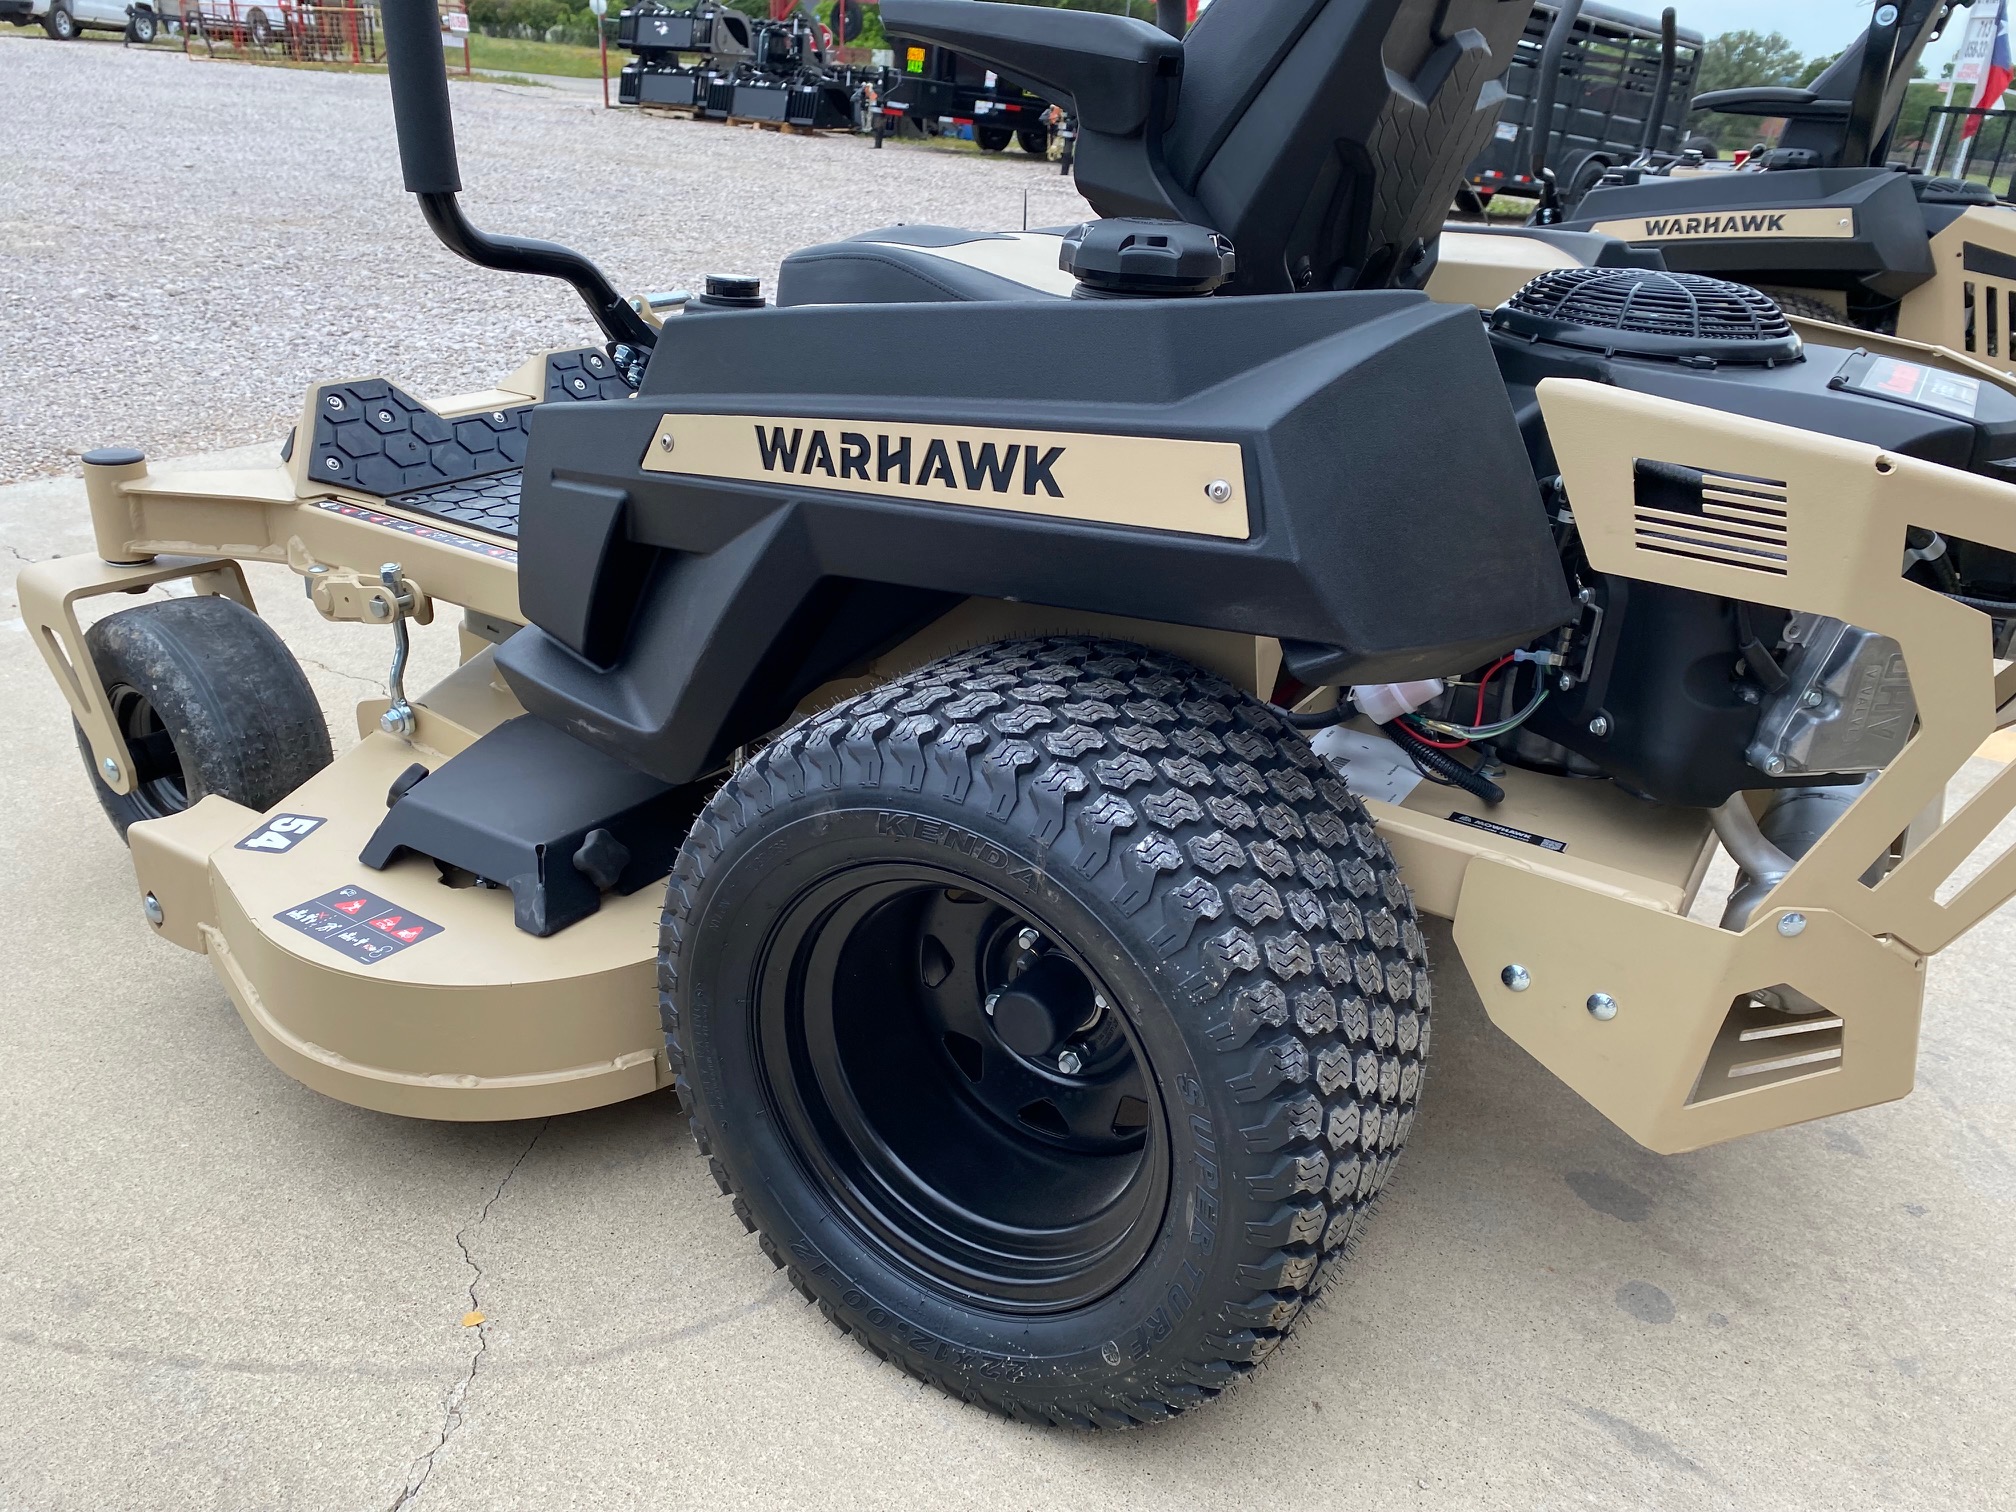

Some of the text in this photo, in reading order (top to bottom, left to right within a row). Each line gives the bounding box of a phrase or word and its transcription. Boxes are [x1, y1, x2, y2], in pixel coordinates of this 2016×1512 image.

[1645, 214, 1787, 236] WARHAWK
[754, 425, 1066, 499] WARHAWK
[245, 816, 320, 850] 54
[876, 811, 1041, 896] KENDA
[1175, 1071, 1220, 1257] SUPER
[1127, 1258, 1207, 1363] TURF
